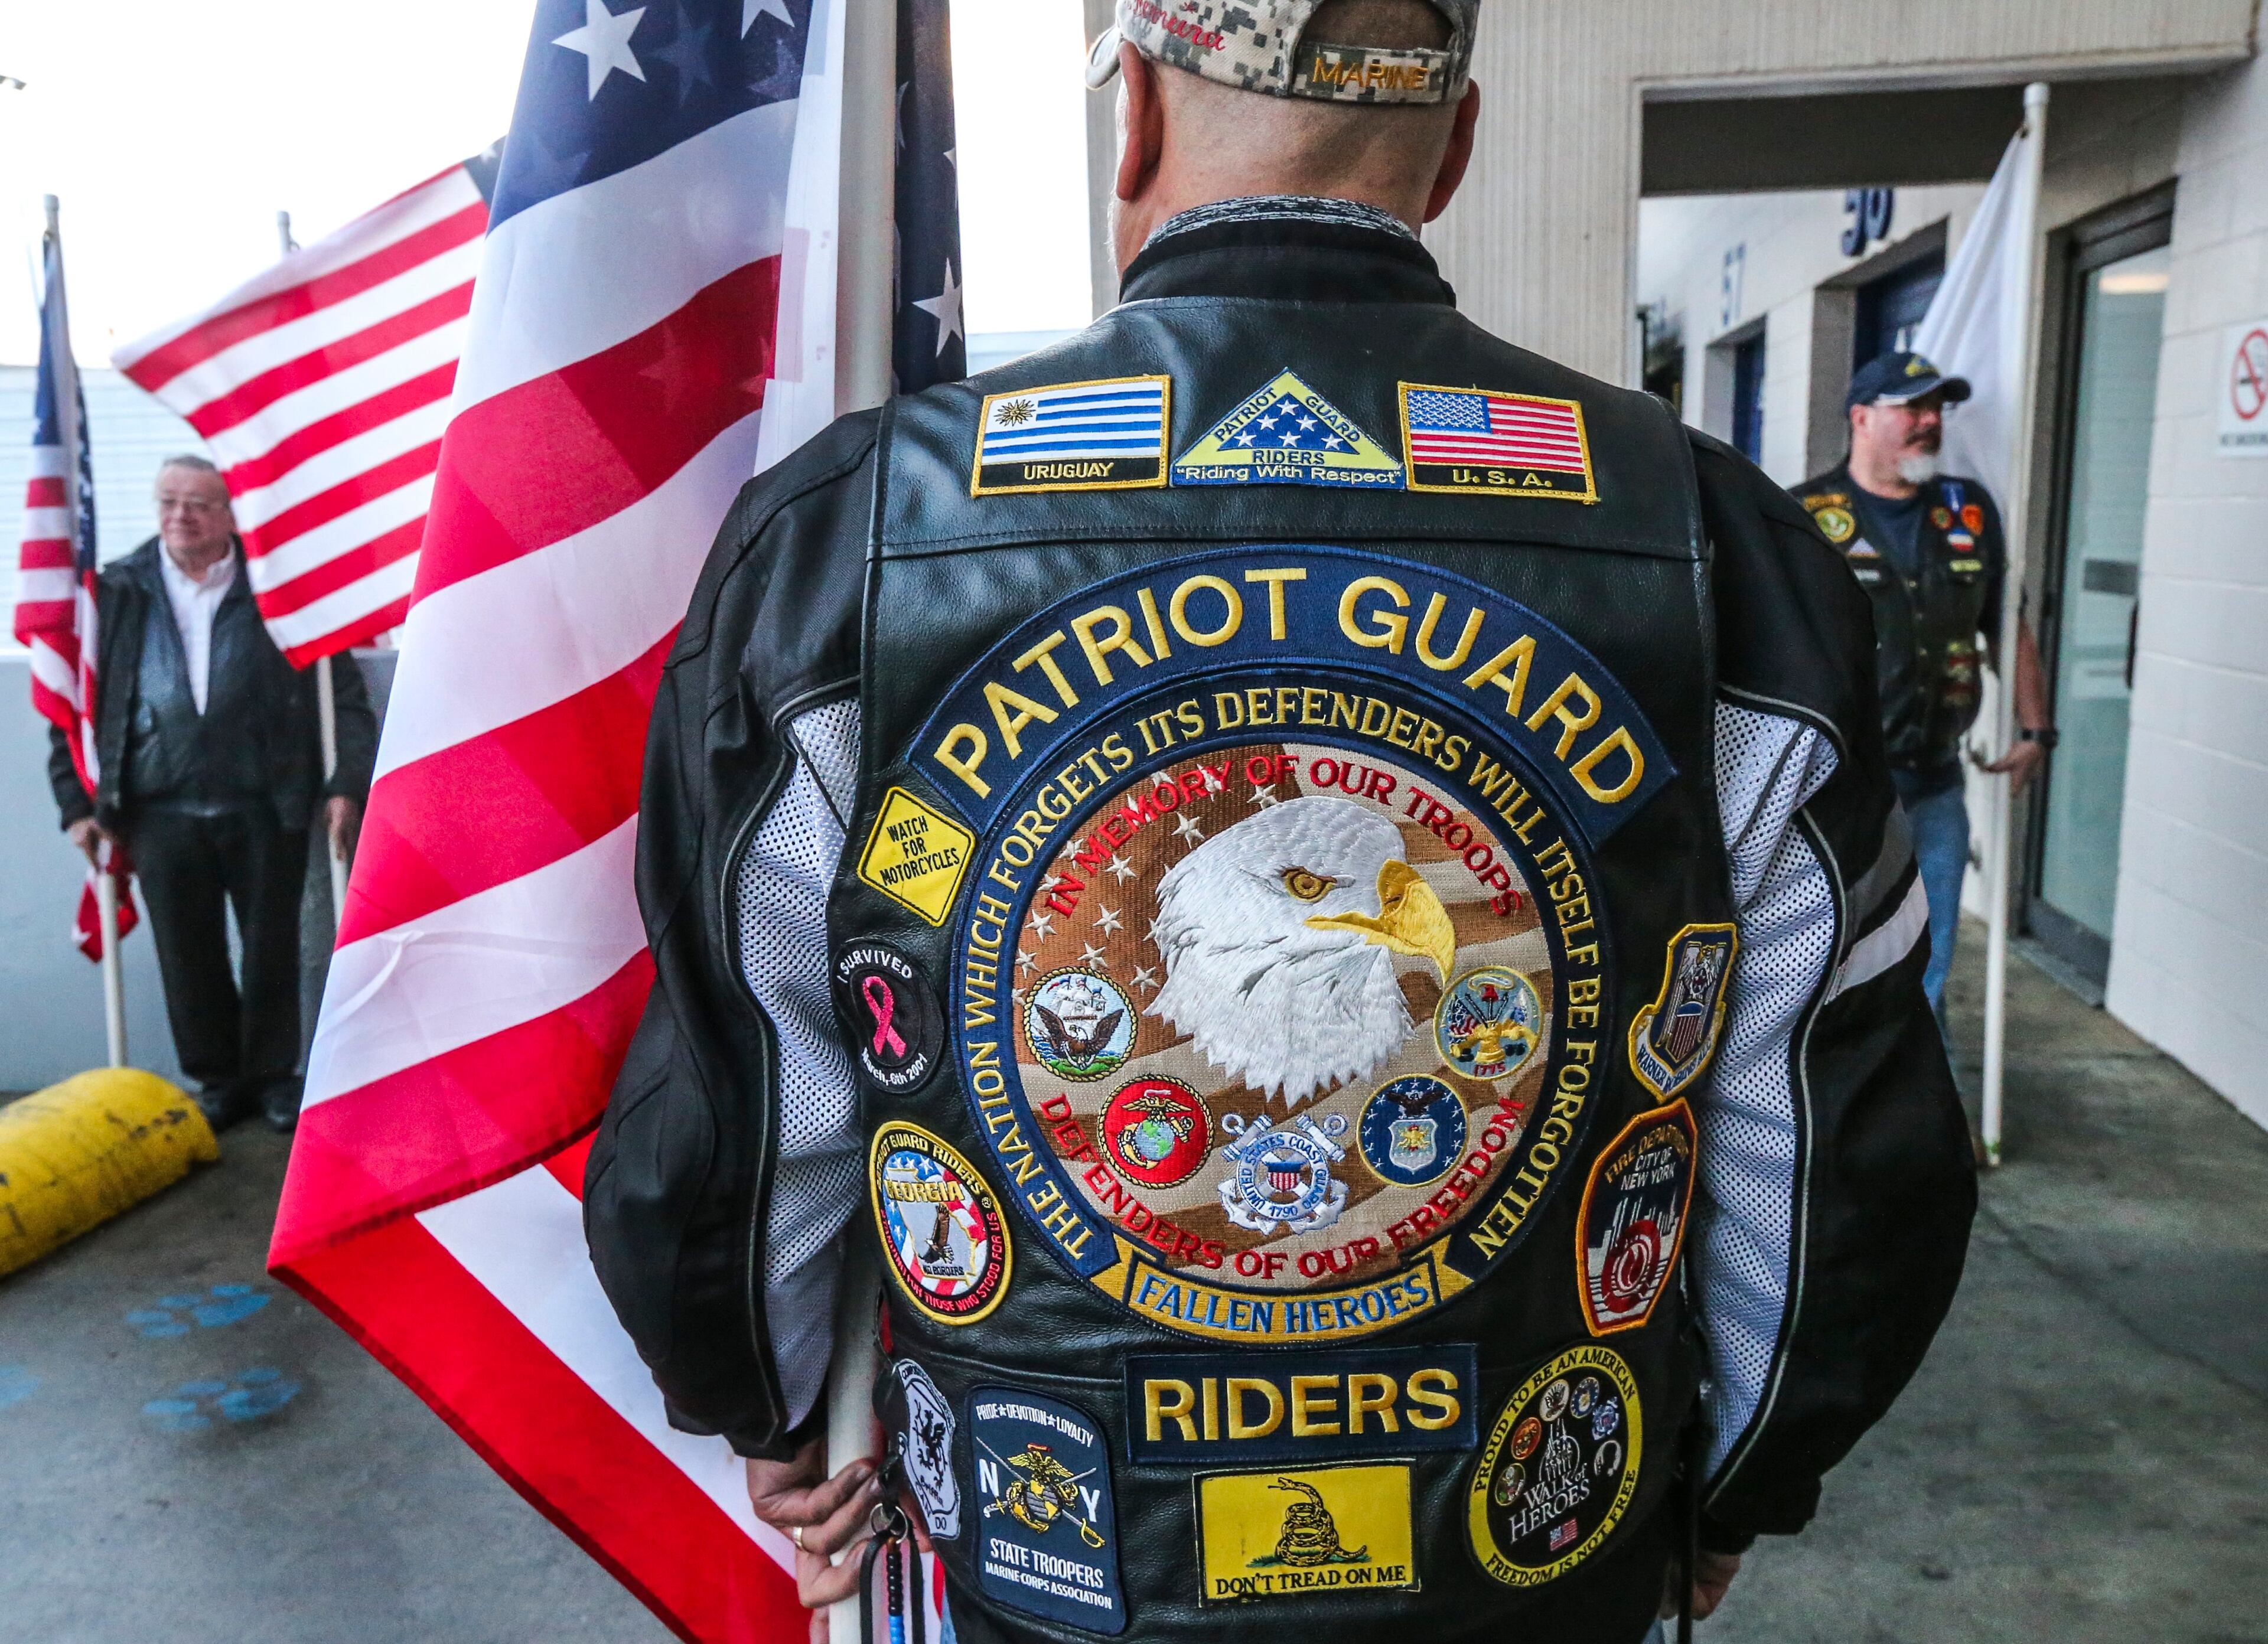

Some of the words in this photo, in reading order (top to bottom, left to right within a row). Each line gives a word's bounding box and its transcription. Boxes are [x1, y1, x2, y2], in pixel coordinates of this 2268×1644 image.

[1313, 57, 1429, 91] MARINE
[1214, 386, 1278, 442] PATRIOT
[1305, 396, 1361, 442] GUARD
[1023, 461, 1115, 481] URUGUAY
[1252, 449, 1325, 465] RIDERS
[1256, 465, 1304, 480] With
[934, 567, 1306, 800] PATRIOT
[1338, 576, 1645, 804] GUARD
[1133, 697, 1205, 756] ITS
[1213, 686, 1472, 771] DEFENDERS
[987, 732, 1134, 893] FORGETS
[1468, 751, 1548, 846] WILL
[887, 816, 928, 842] WATCH
[901, 837, 927, 859] FOR
[1044, 870, 1086, 918] IN
[1073, 759, 1233, 878] MEMORY
[1246, 754, 1299, 785] OF
[1309, 757, 1397, 806] OUR
[1403, 786, 1522, 916] TROOPS
[879, 847, 960, 886] MOTORCYCLES
[1533, 836, 1600, 966] ITSELF
[840, 949, 913, 979] SURVIVED
[965, 891, 1012, 1030] WHICH
[1566, 974, 1601, 1029] BE
[906, 1053, 928, 1081] 2001
[1474, 1062, 1506, 1078] 1775
[1637, 1043, 1664, 1087] WARNER
[966, 1040, 1045, 1188] NATION
[889, 1133, 928, 1152] GUARD
[933, 1144, 984, 1195] RIDERS
[1246, 1134, 1285, 1166] STATES
[1289, 1136, 1324, 1164] COAST
[1469, 1038, 1598, 1261] FORGOTTEN
[1605, 1144, 1635, 1183] FIRE
[1635, 1151, 1661, 1172] CITY
[1660, 1146, 1673, 1164] OF
[884, 1180, 966, 1202] GEORGIA
[1040, 1093, 1226, 1270] DEFENDERS
[1234, 1250, 1289, 1280] OF
[1297, 1237, 1381, 1278] OUR
[1387, 1097, 1526, 1251] FREEDOM
[1241, 1168, 1265, 1210] UNITED
[1302, 1169, 1327, 1209] GUARD
[1621, 1171, 1649, 1190] NEW
[1651, 1162, 1676, 1185] YORK
[986, 1212, 1000, 1231] US
[1026, 1179, 1094, 1260] THE
[1269, 1206, 1298, 1217] 1790
[991, 1235, 1003, 1260] FOR
[933, 1265, 964, 1276] BORDERS
[976, 1262, 1001, 1298] STOOD
[925, 1292, 955, 1312] THOSE
[956, 1294, 980, 1312] WHO
[1135, 1273, 1275, 1333] FALLEN
[1285, 1273, 1430, 1333] HEROES
[976, 1402, 999, 1421] PRIDE
[1006, 1404, 1047, 1426] DEVOTION
[1056, 1417, 1094, 1448] LOYALTY
[1144, 1368, 1461, 1441] RIDERS
[1474, 1418, 1509, 1493] PROUD
[1507, 1388, 1530, 1414] TO
[1533, 1364, 1553, 1387] BE
[1556, 1351, 1578, 1374] AN
[1579, 1349, 1635, 1402] AMERICAN
[979, 1459, 999, 1496] N
[1079, 1485, 1101, 1523] Y
[1524, 1475, 1573, 1509] WALK
[1574, 1462, 1588, 1482] of
[1485, 1553, 1555, 1586] FREEDOM
[1558, 1557, 1573, 1577] IS
[1577, 1524, 1610, 1565] NOT
[1609, 1469, 1637, 1520] FREE
[1508, 1479, 1591, 1545] HEROES
[985, 1561, 1019, 1583] MARINE
[1019, 1573, 1050, 1593] CORPS
[1051, 1582, 1113, 1610] ASSOCIATION
[990, 1538, 1030, 1568] STATE
[1032, 1549, 1104, 1589] TROOPERS
[1216, 1573, 1275, 1596] DON'T
[1278, 1570, 1341, 1590] TREAD
[1345, 1568, 1371, 1586] ON
[1376, 1565, 1407, 1583] ME
